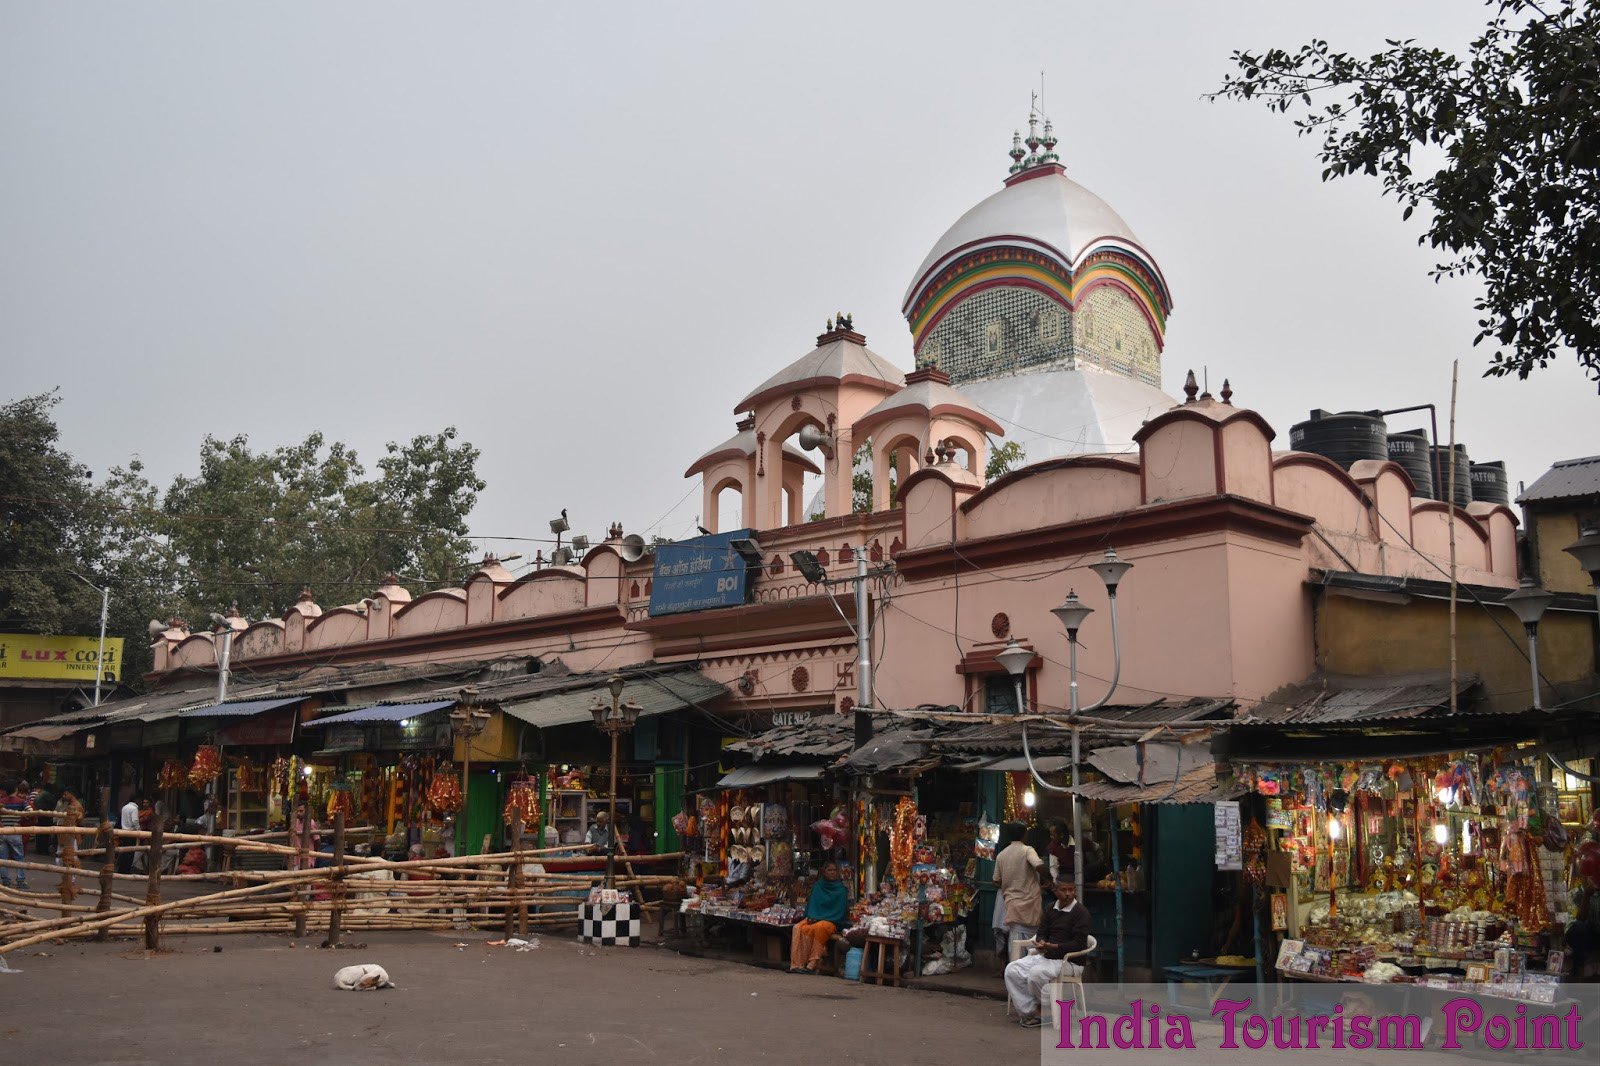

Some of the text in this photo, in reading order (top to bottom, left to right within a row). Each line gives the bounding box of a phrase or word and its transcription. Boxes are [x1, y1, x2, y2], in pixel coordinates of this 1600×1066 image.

[717, 576, 738, 593] BOI
[20, 649, 68, 661] LUX
[772, 711, 793, 726] GATE
